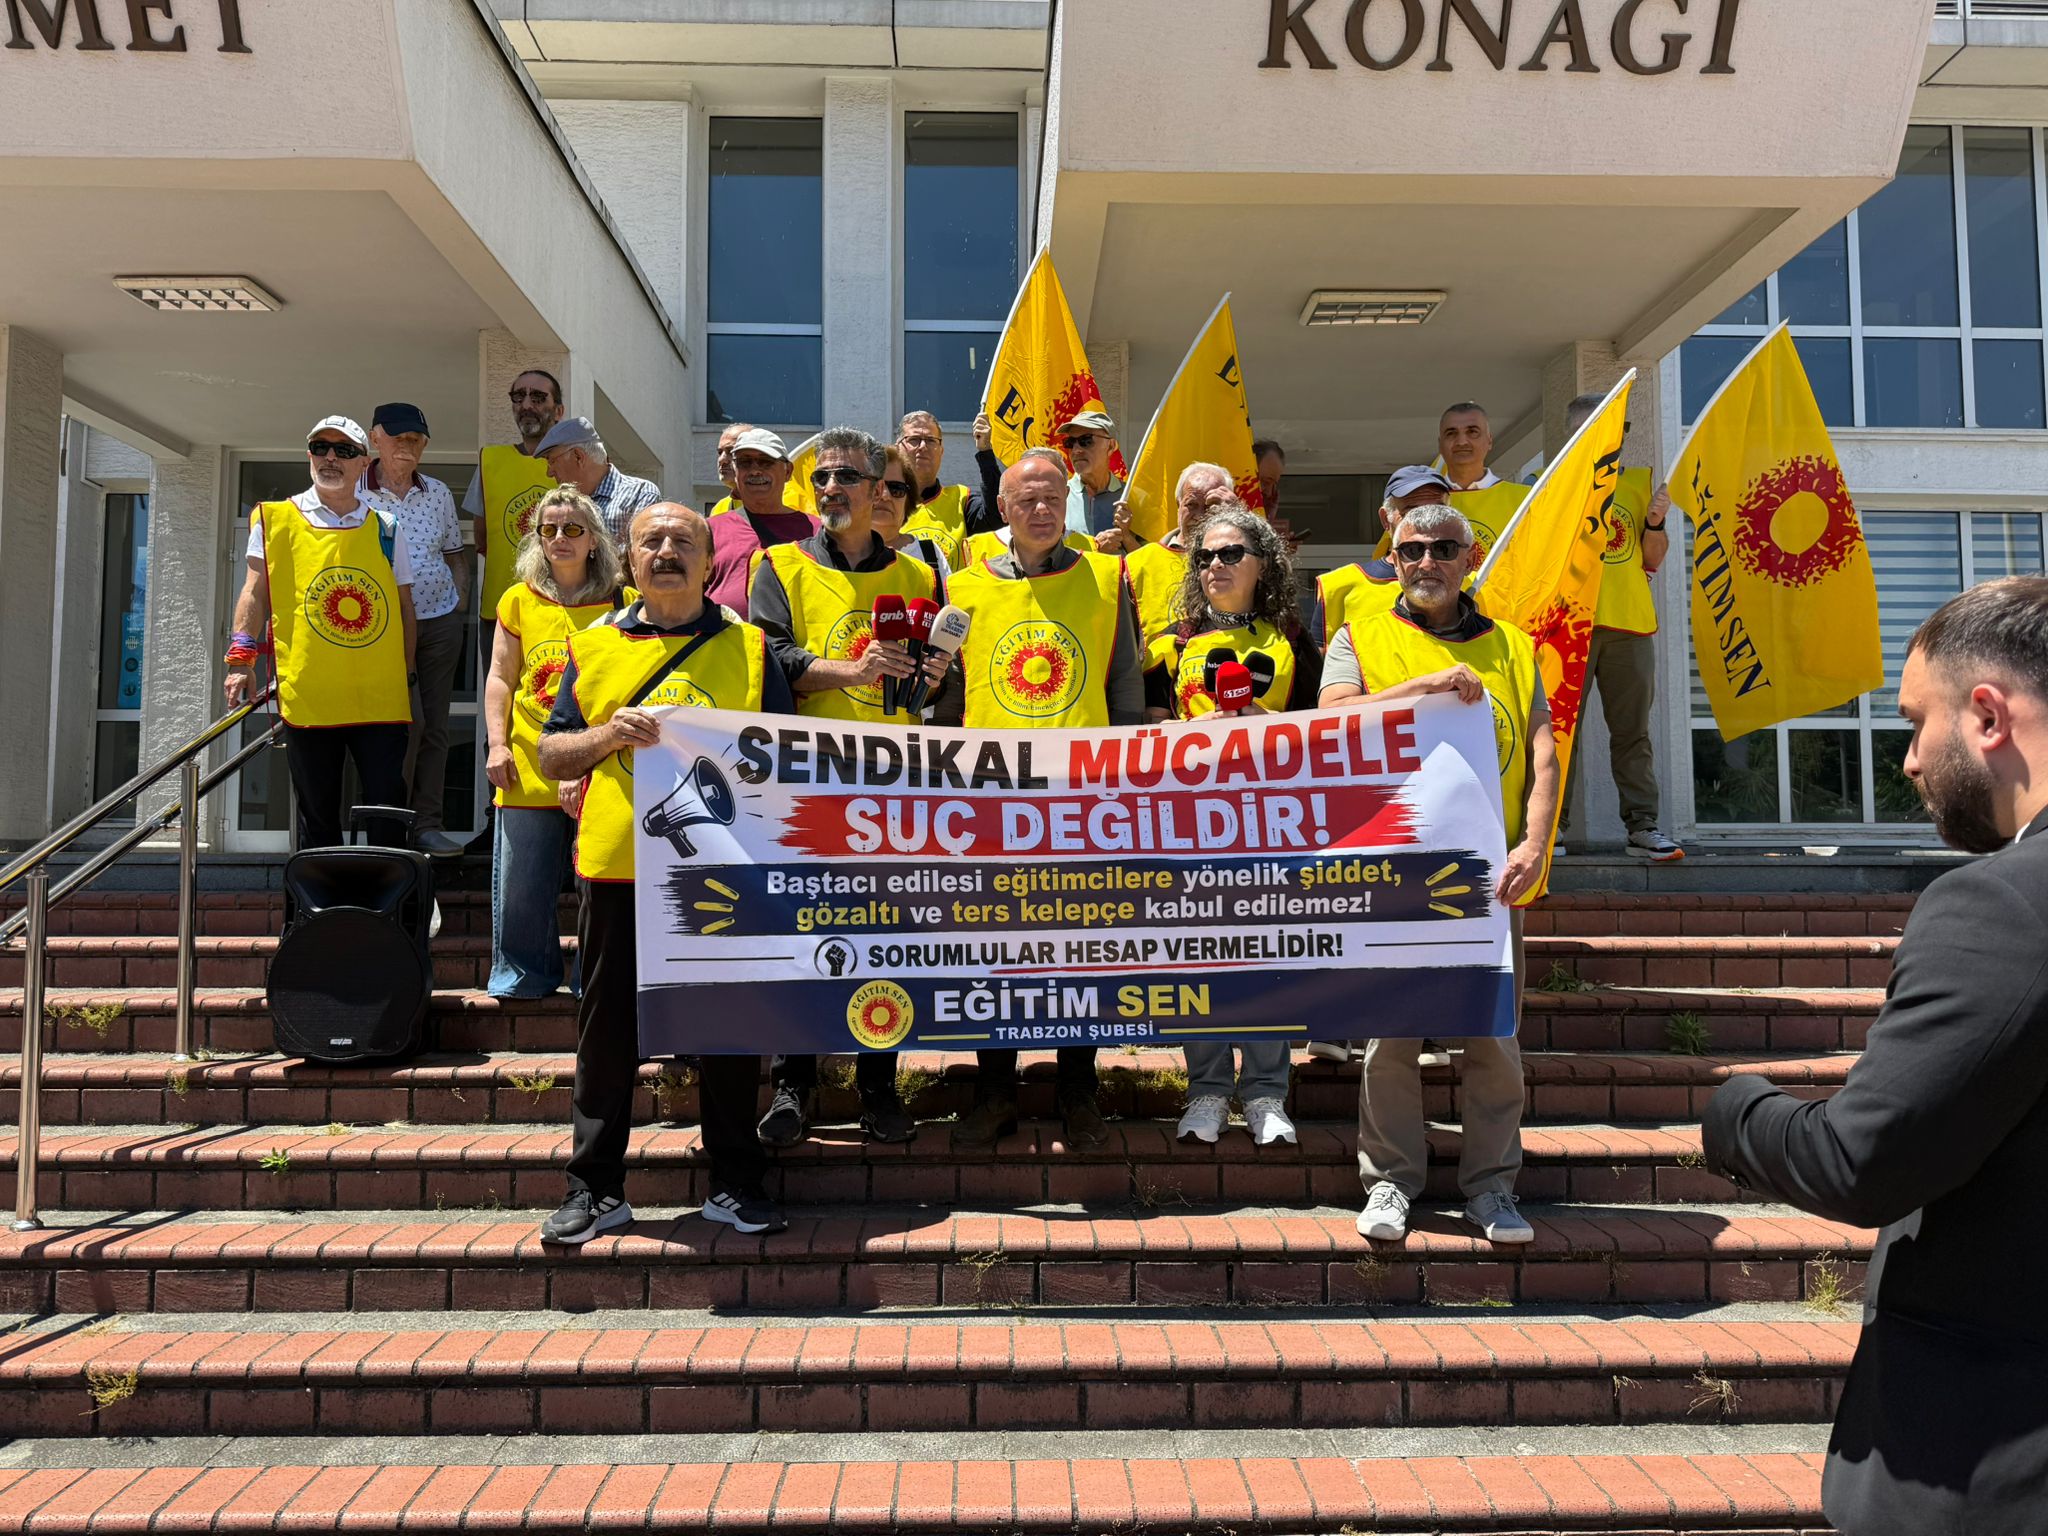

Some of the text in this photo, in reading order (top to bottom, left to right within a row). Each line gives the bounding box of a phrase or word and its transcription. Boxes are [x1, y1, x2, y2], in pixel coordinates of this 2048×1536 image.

[311, 571, 381, 602] EĞİTİM SEN
[879, 610, 904, 623] gnb
[995, 627, 1078, 667] EĞİTİM SEN
[1720, 616, 1772, 699] SEN
[737, 708, 1422, 790] SENDİKAL MÜCADELE
[845, 793, 1331, 858] SUÇ DEĞİLDİR!
[767, 859, 1402, 899] Baştacı edilesi eğitimcilere yönelik şiddet,
[796, 892, 1372, 932] gözaltı ve ters kelepçe kabul edilemez!
[869, 929, 1343, 968] SORUMLULAR HESAP VERMELİDİR!
[852, 983, 910, 1010] EĞİTİM SEN
[934, 981, 1212, 1023] EĞİTİM SEN
[996, 1019, 1154, 1041] TRABZON ŞUBESİ
